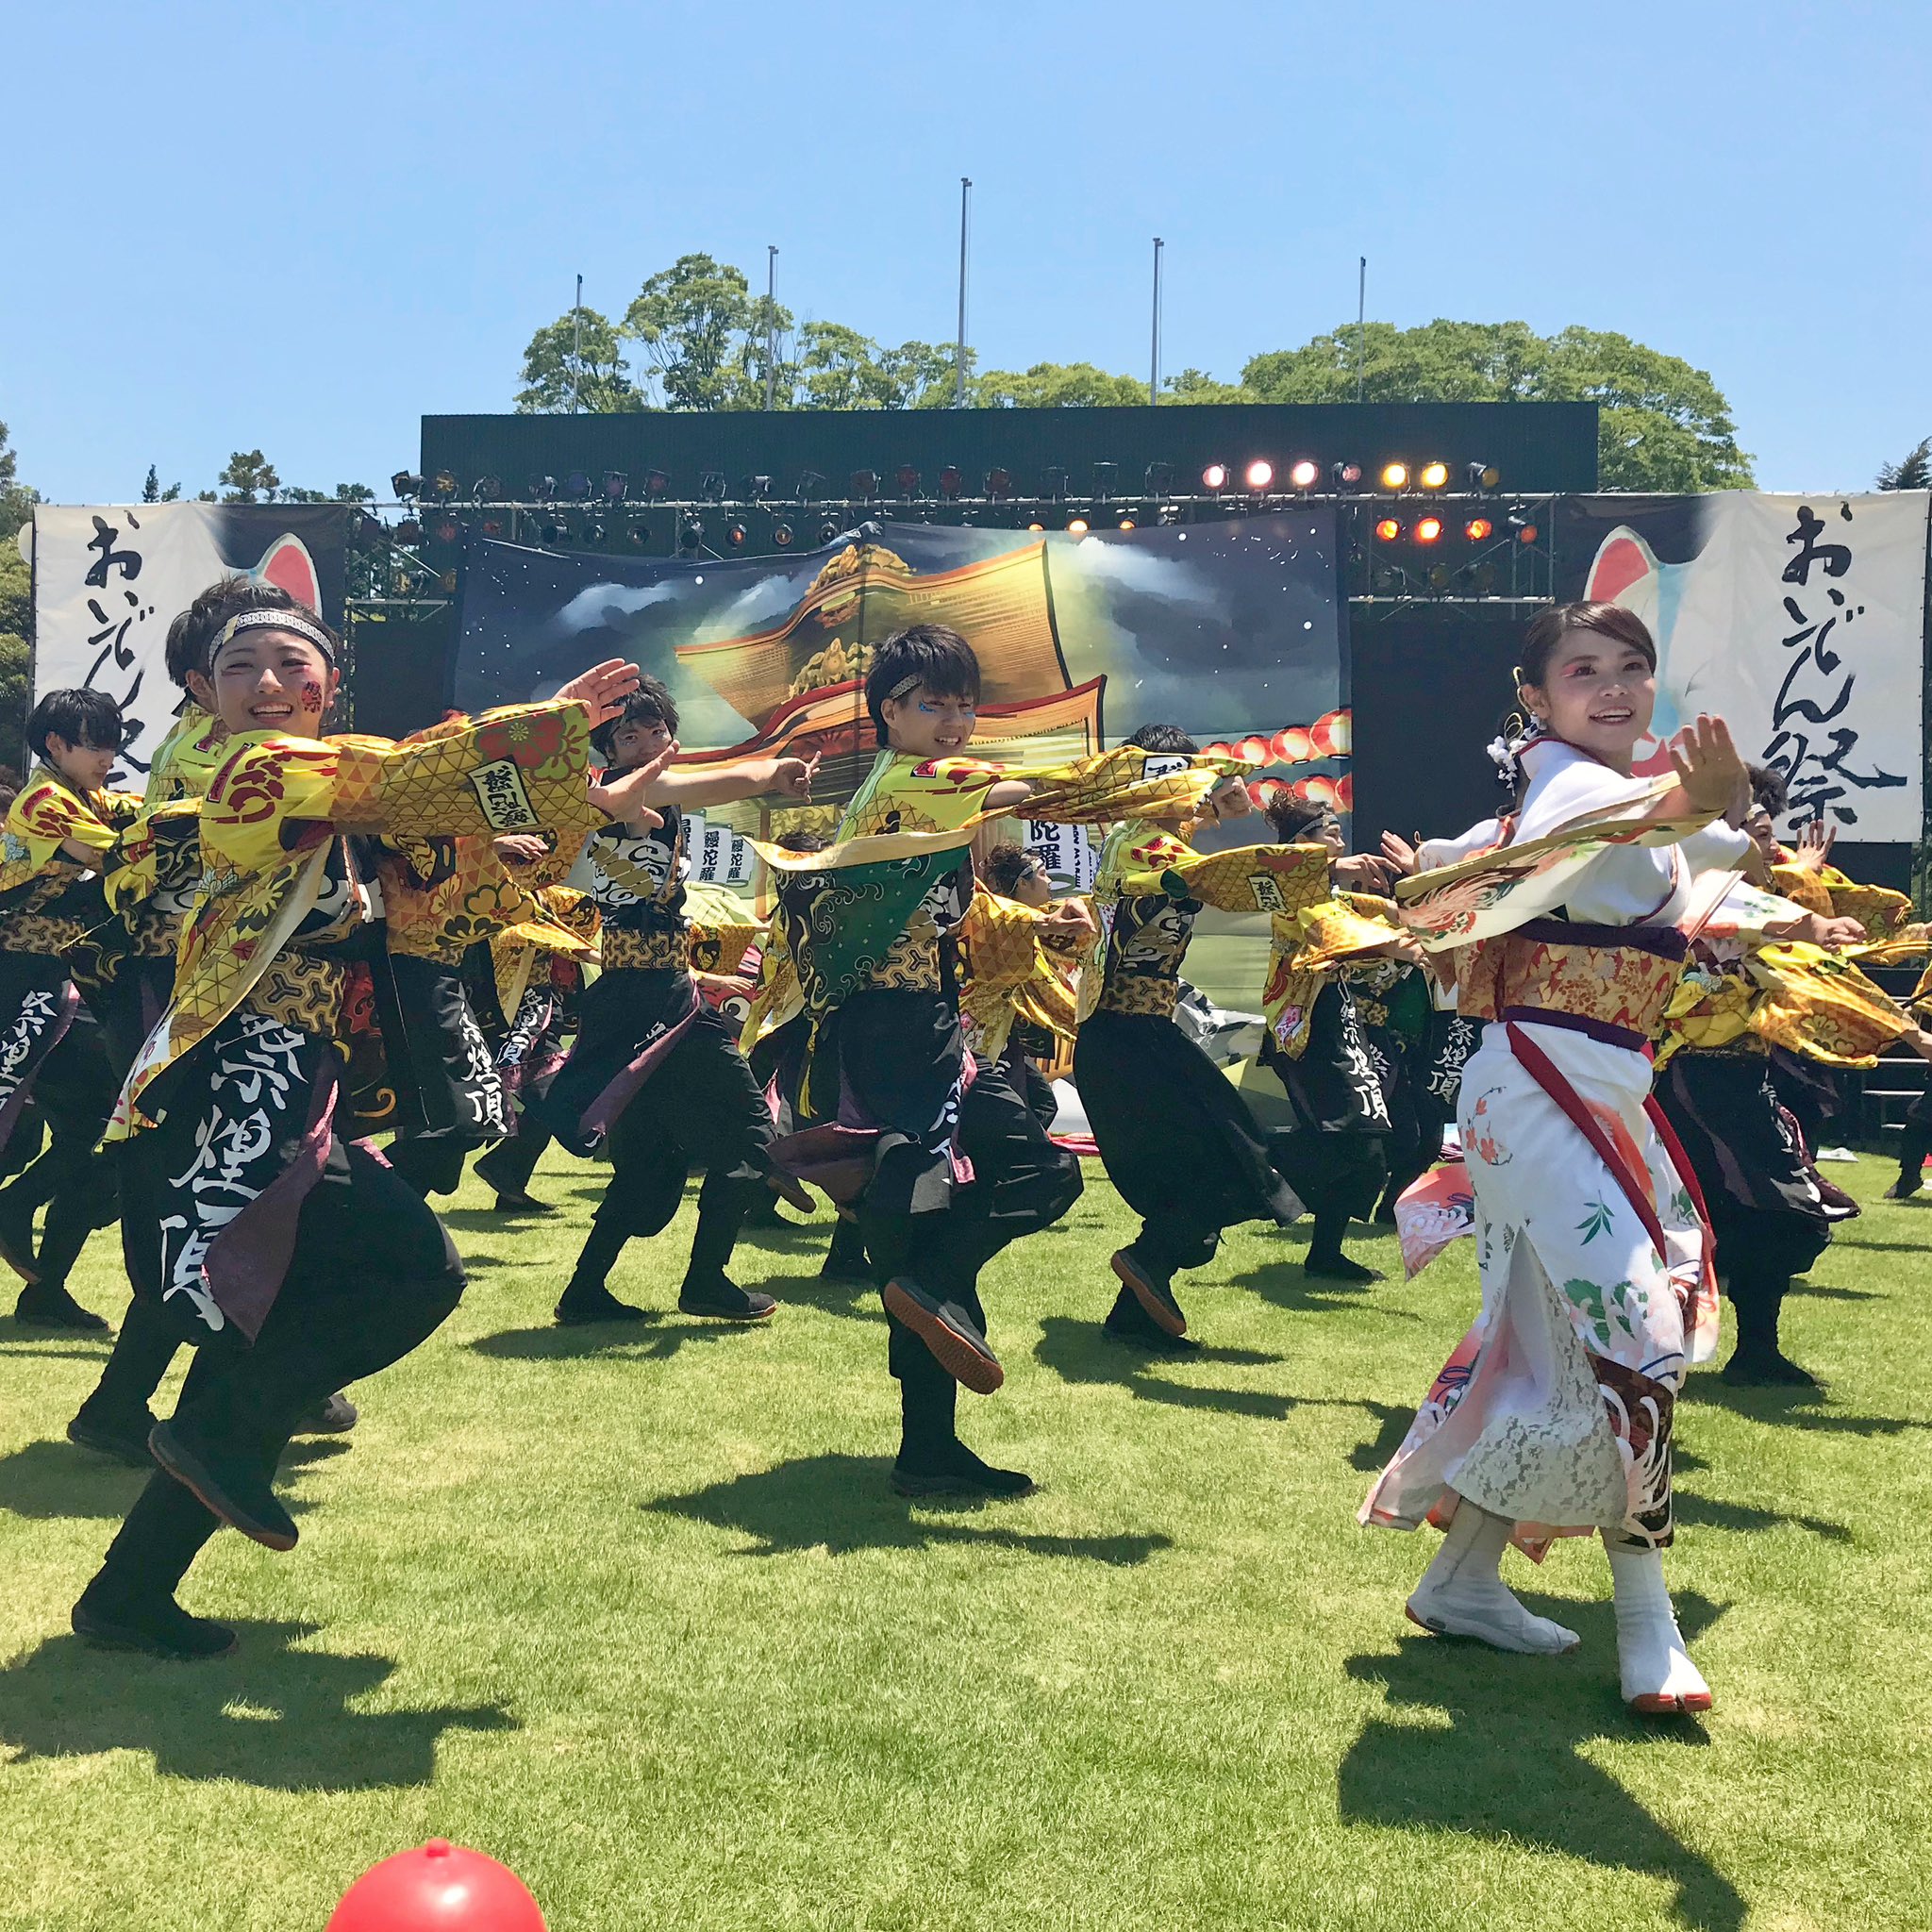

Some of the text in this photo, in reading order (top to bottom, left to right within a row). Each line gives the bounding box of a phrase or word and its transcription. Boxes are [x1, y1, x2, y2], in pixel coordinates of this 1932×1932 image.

[1763, 500, 1907, 831] おいでん祭
